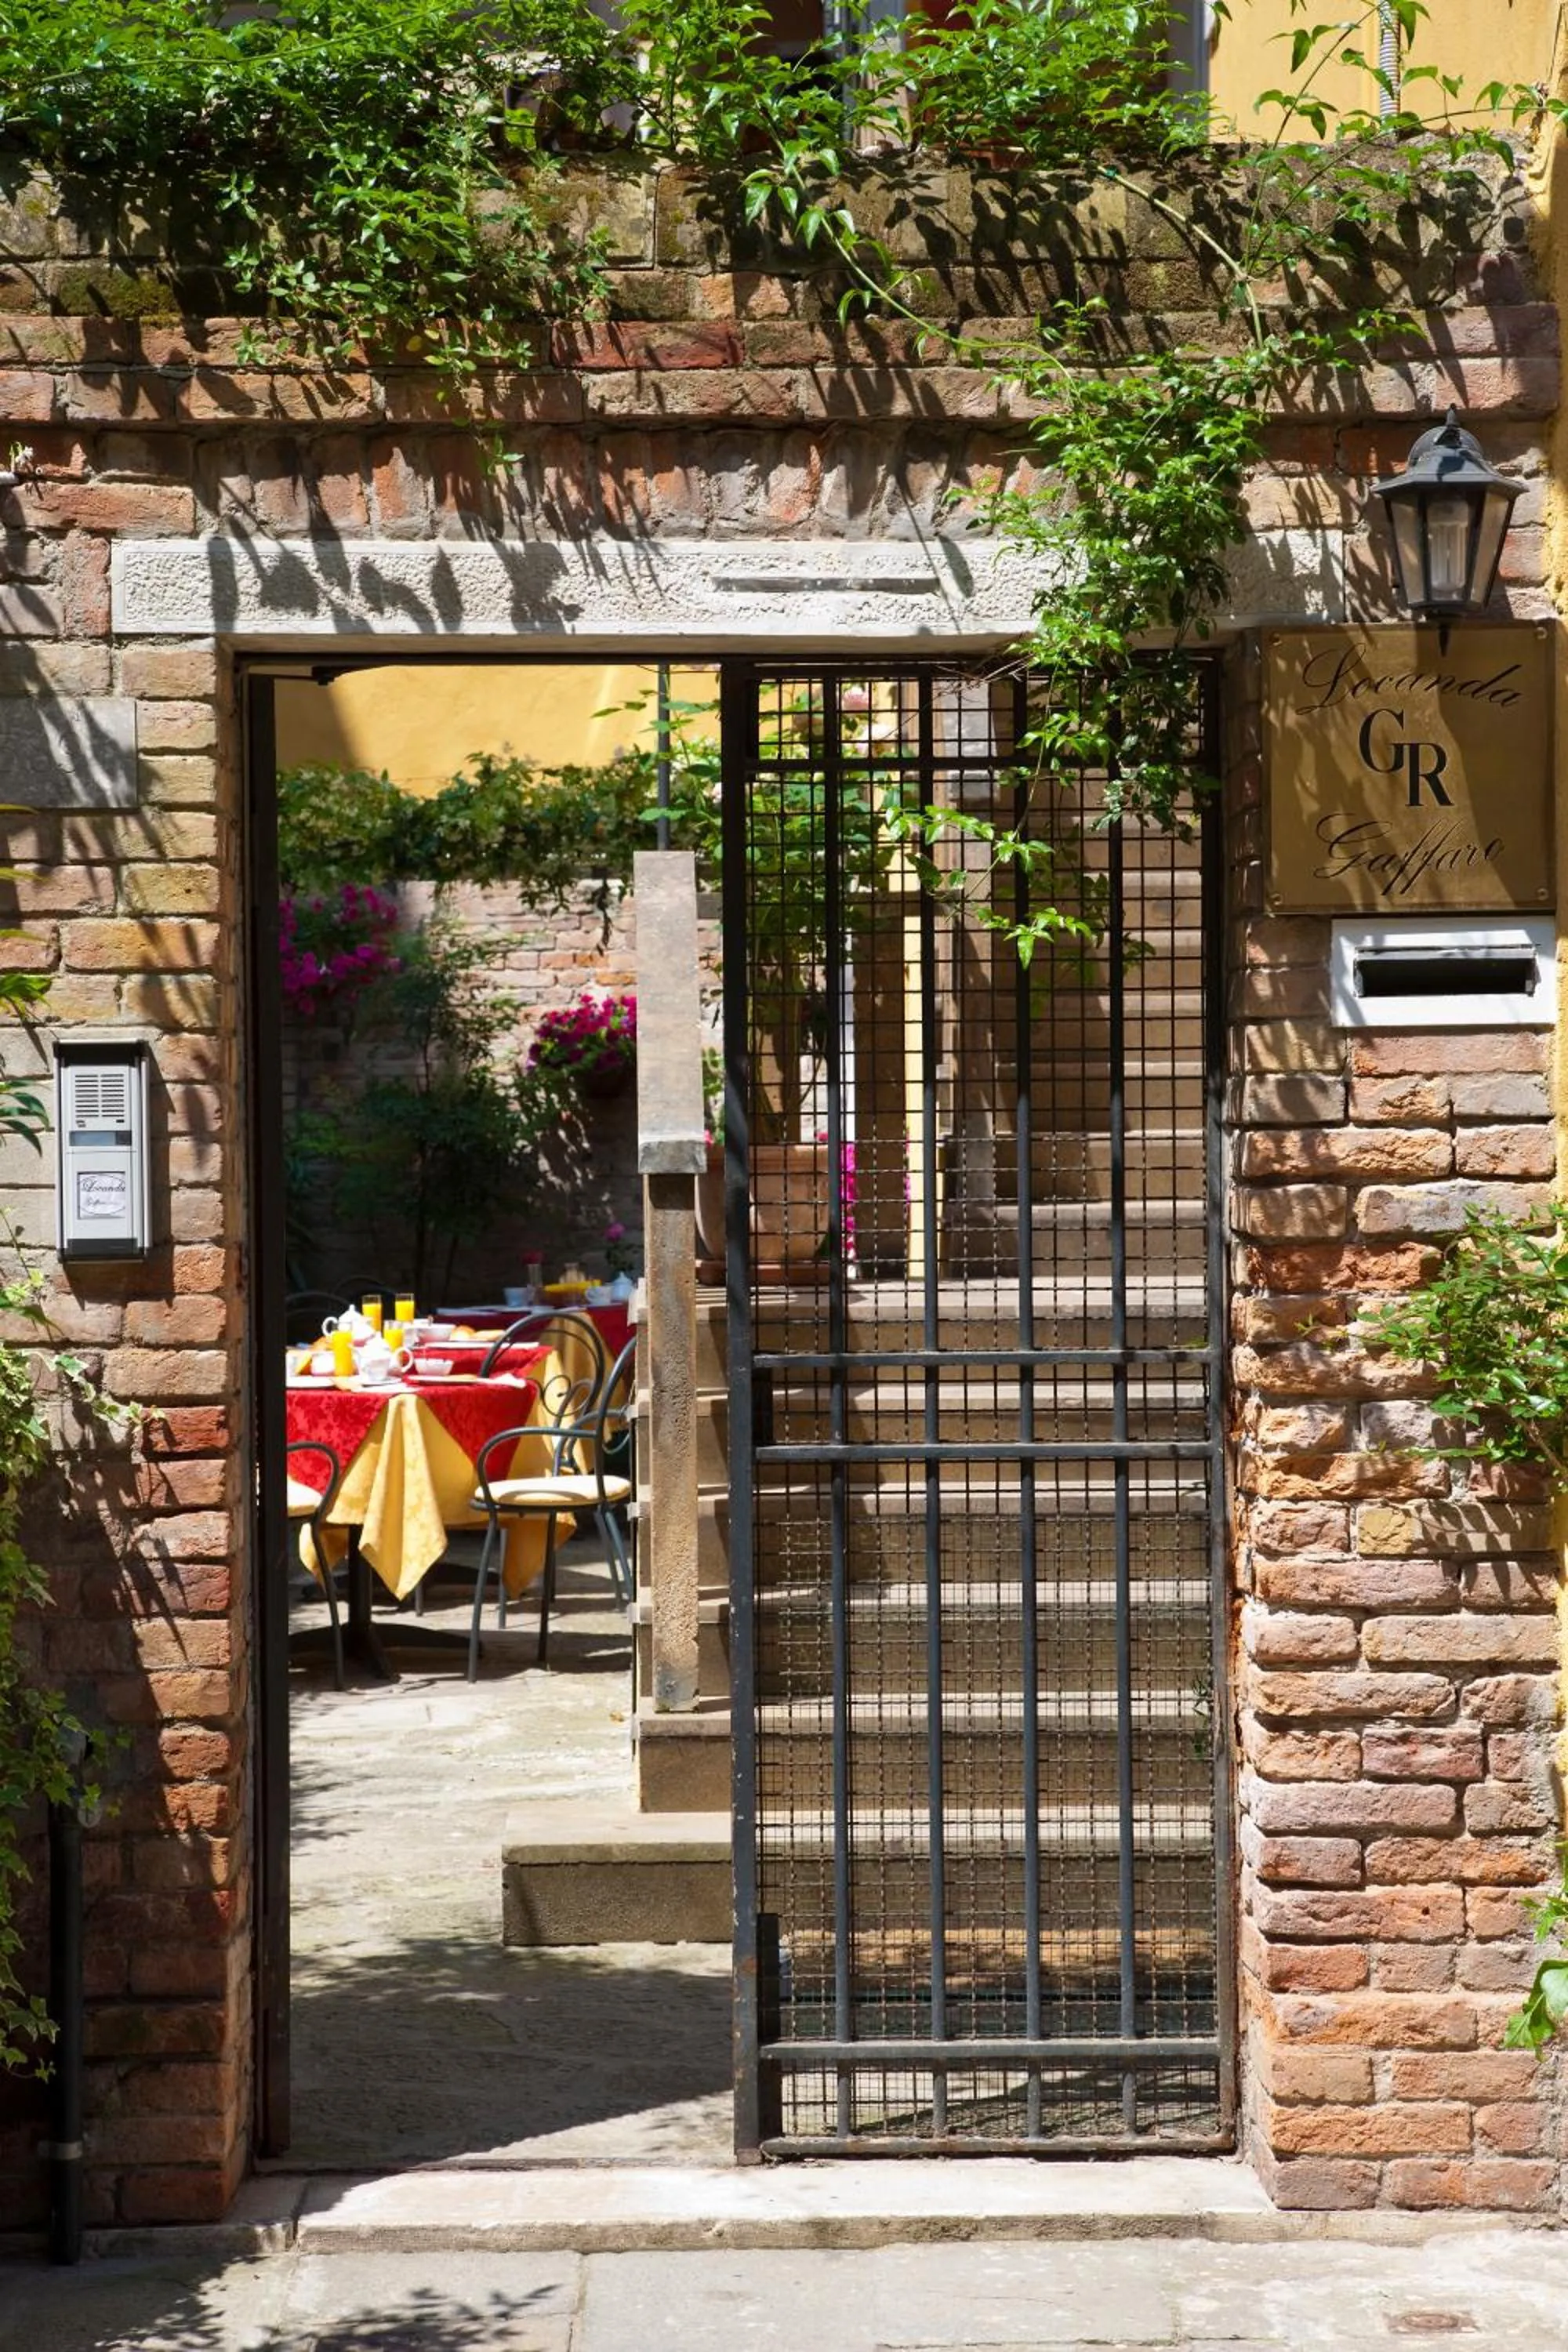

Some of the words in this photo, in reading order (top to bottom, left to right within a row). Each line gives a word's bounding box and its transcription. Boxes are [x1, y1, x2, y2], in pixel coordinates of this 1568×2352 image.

[1295, 642, 1523, 716] Locanda
[1359, 708, 1455, 808] GR
[1314, 813, 1505, 896] Gaffaro
